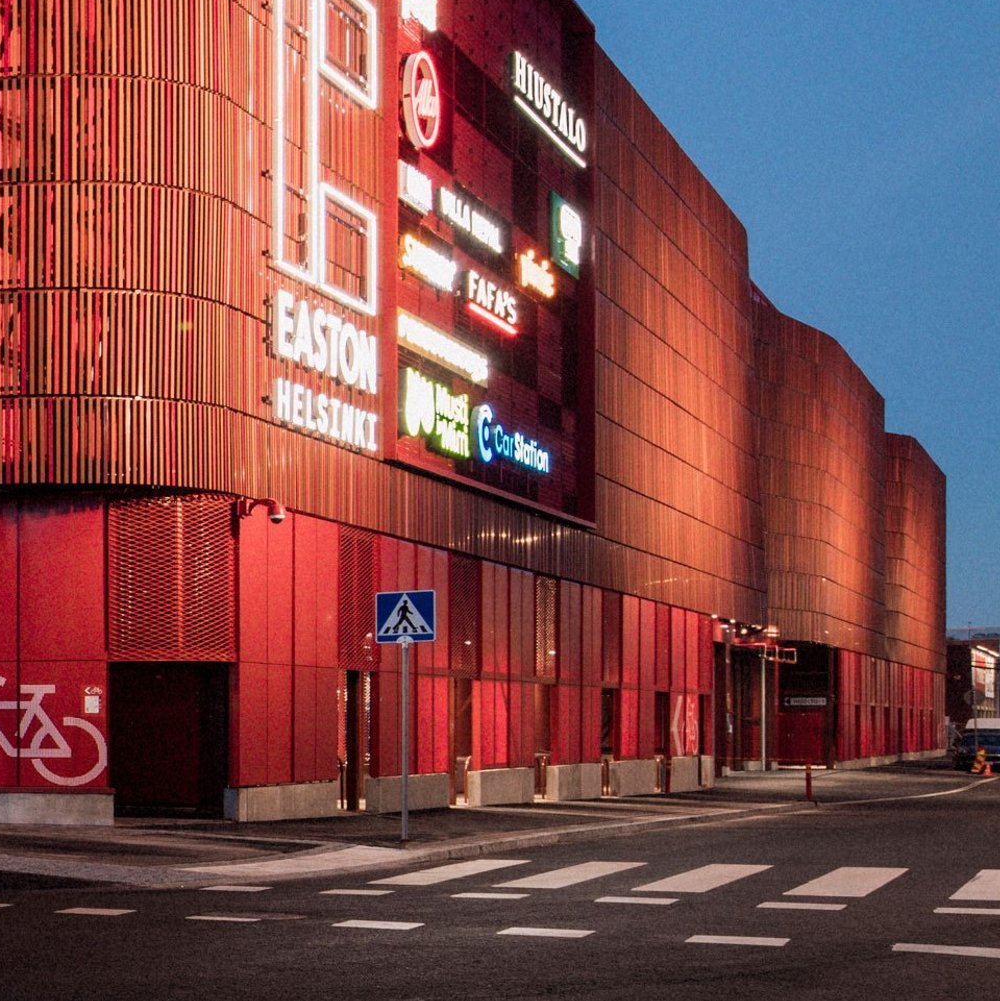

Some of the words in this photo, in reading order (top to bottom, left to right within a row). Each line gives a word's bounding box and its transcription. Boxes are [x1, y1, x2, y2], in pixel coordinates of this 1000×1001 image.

[514, 51, 586, 152] HIUSTALO
[468, 269, 517, 324] FAFA'S
[277, 289, 377, 395] EASTON
[276, 377, 377, 451] HELSINKI
